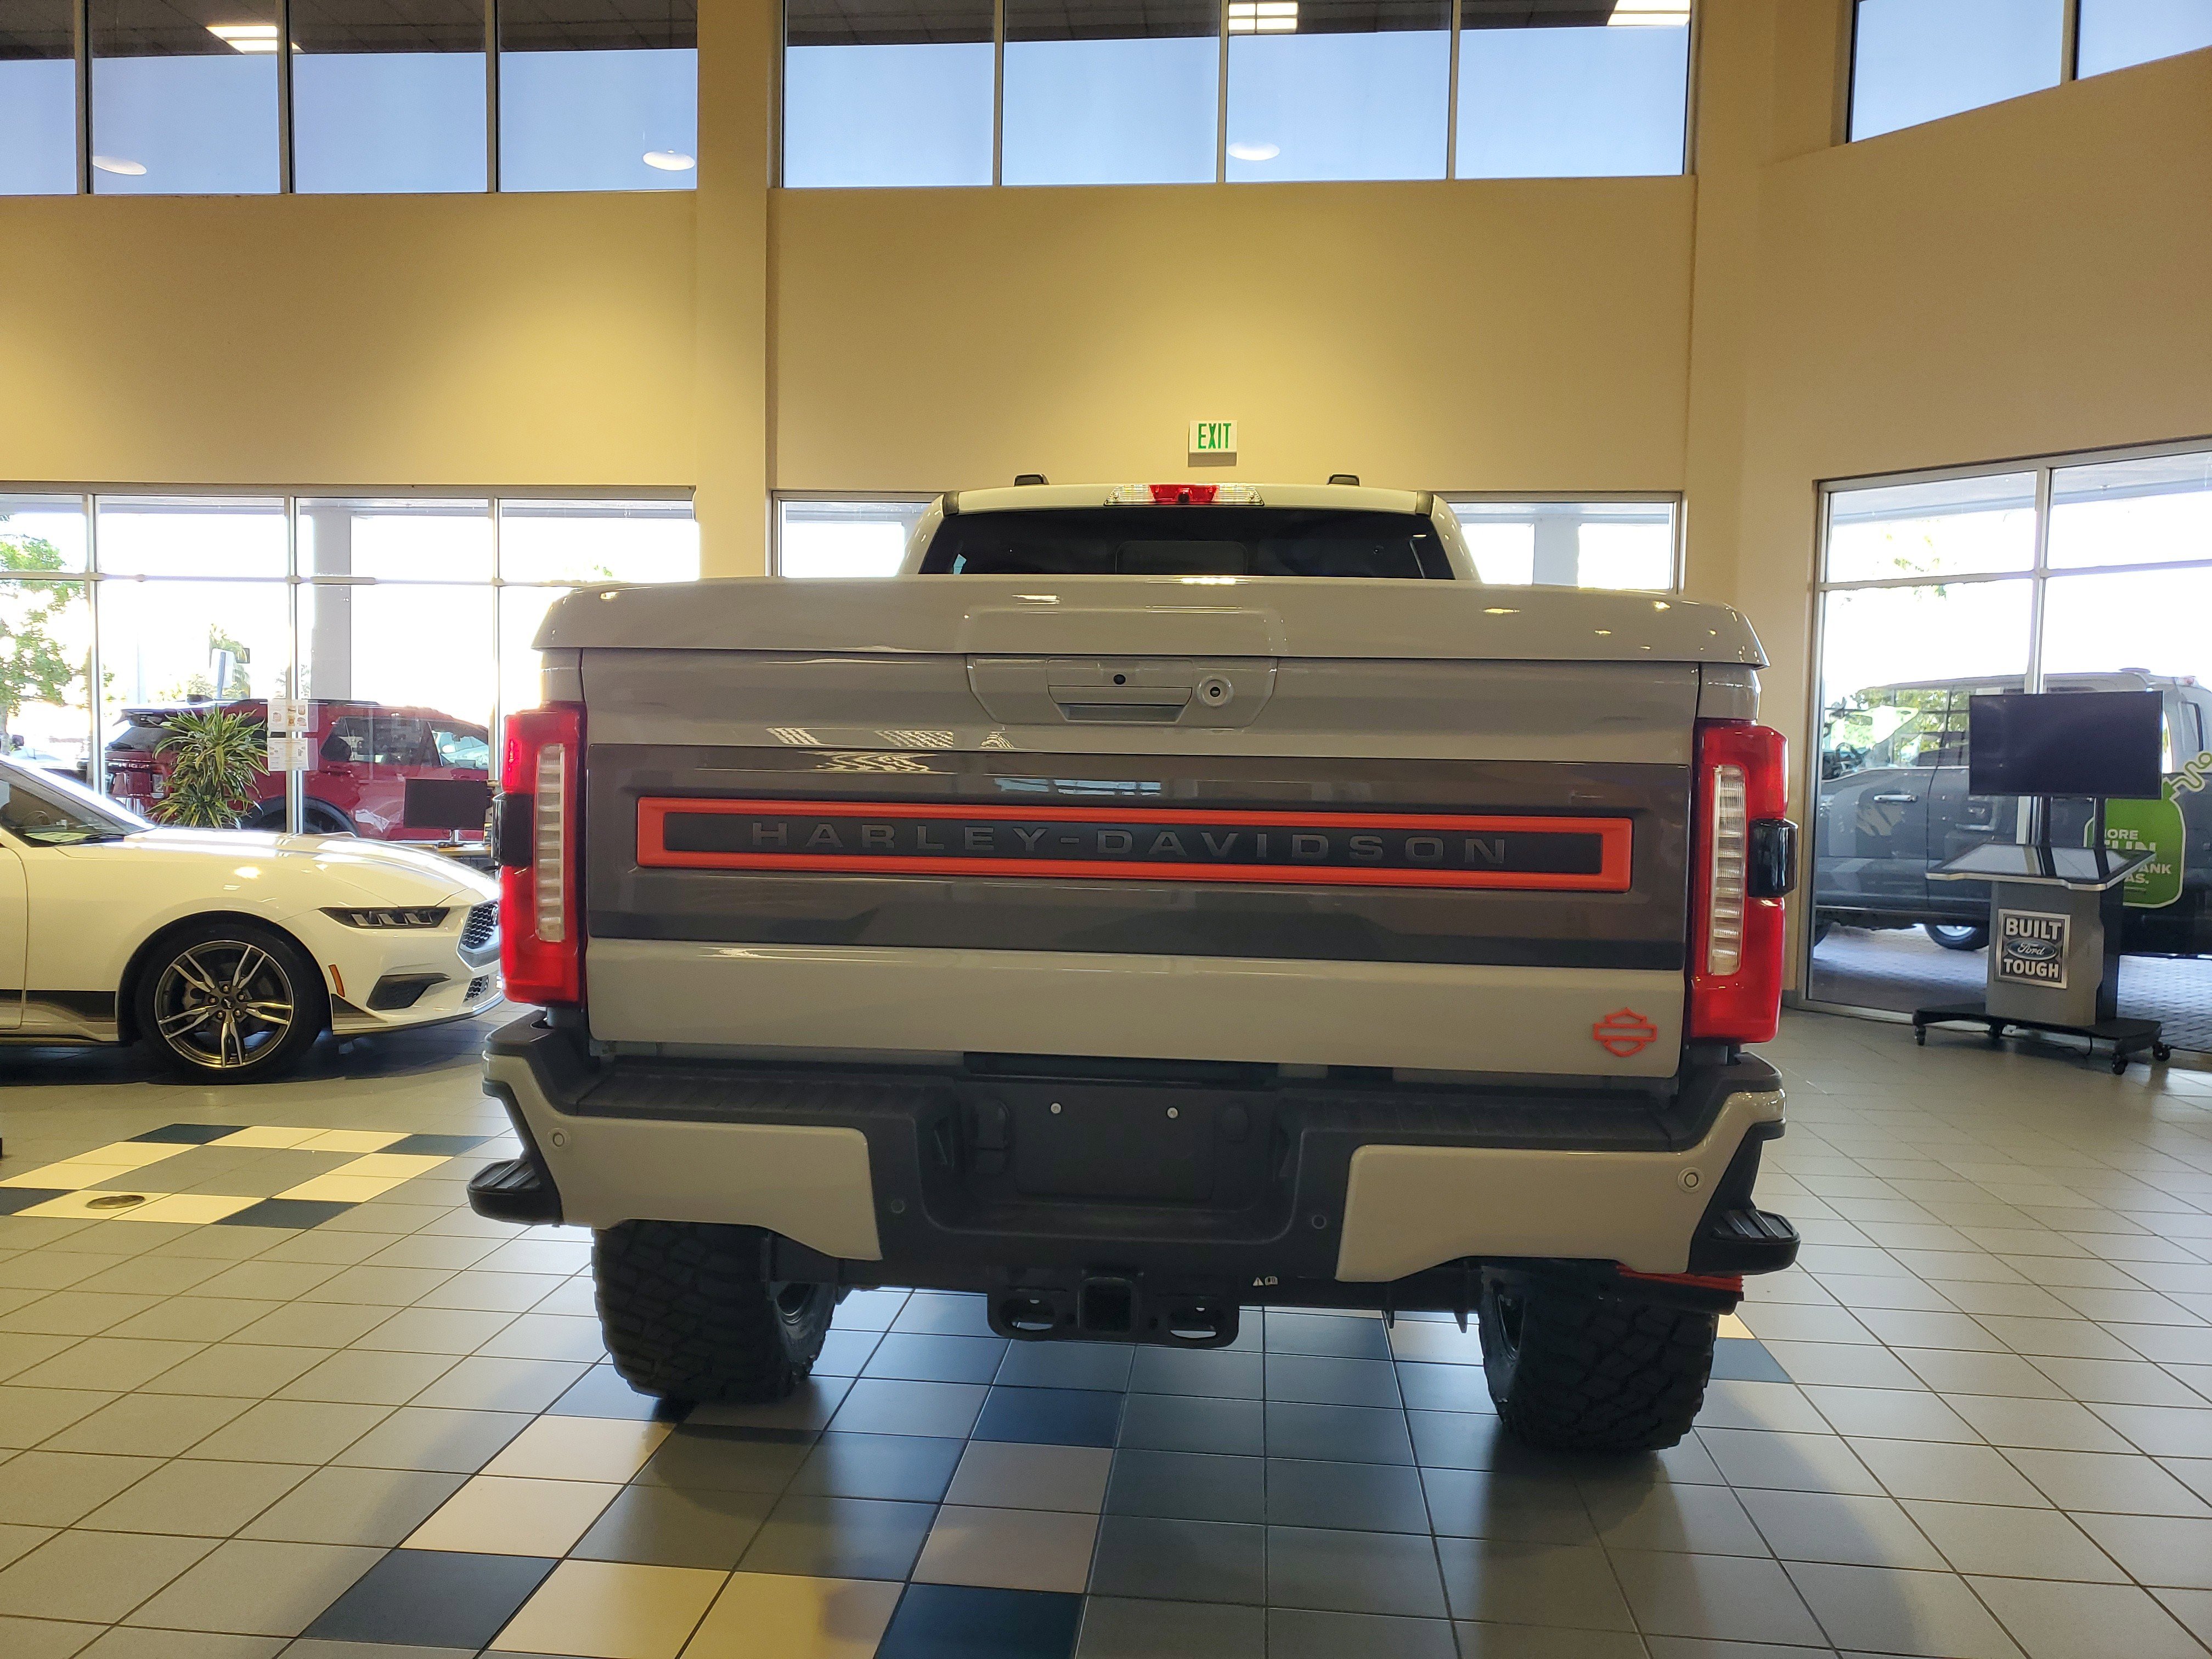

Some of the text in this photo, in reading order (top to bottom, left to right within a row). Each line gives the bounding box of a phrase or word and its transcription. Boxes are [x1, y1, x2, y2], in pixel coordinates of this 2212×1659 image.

[1198, 423, 1232, 449] EXIT
[2105, 828, 2138, 840] ORE
[752, 821, 1505, 865] HARLEY-DAVIDSON
[2138, 862, 2172, 874] ANK
[2124, 873, 2149, 884] AS.
[2006, 918, 2062, 940] BUILT
[2017, 942, 2046, 955] Ford
[2004, 958, 2059, 978] TOUGH
